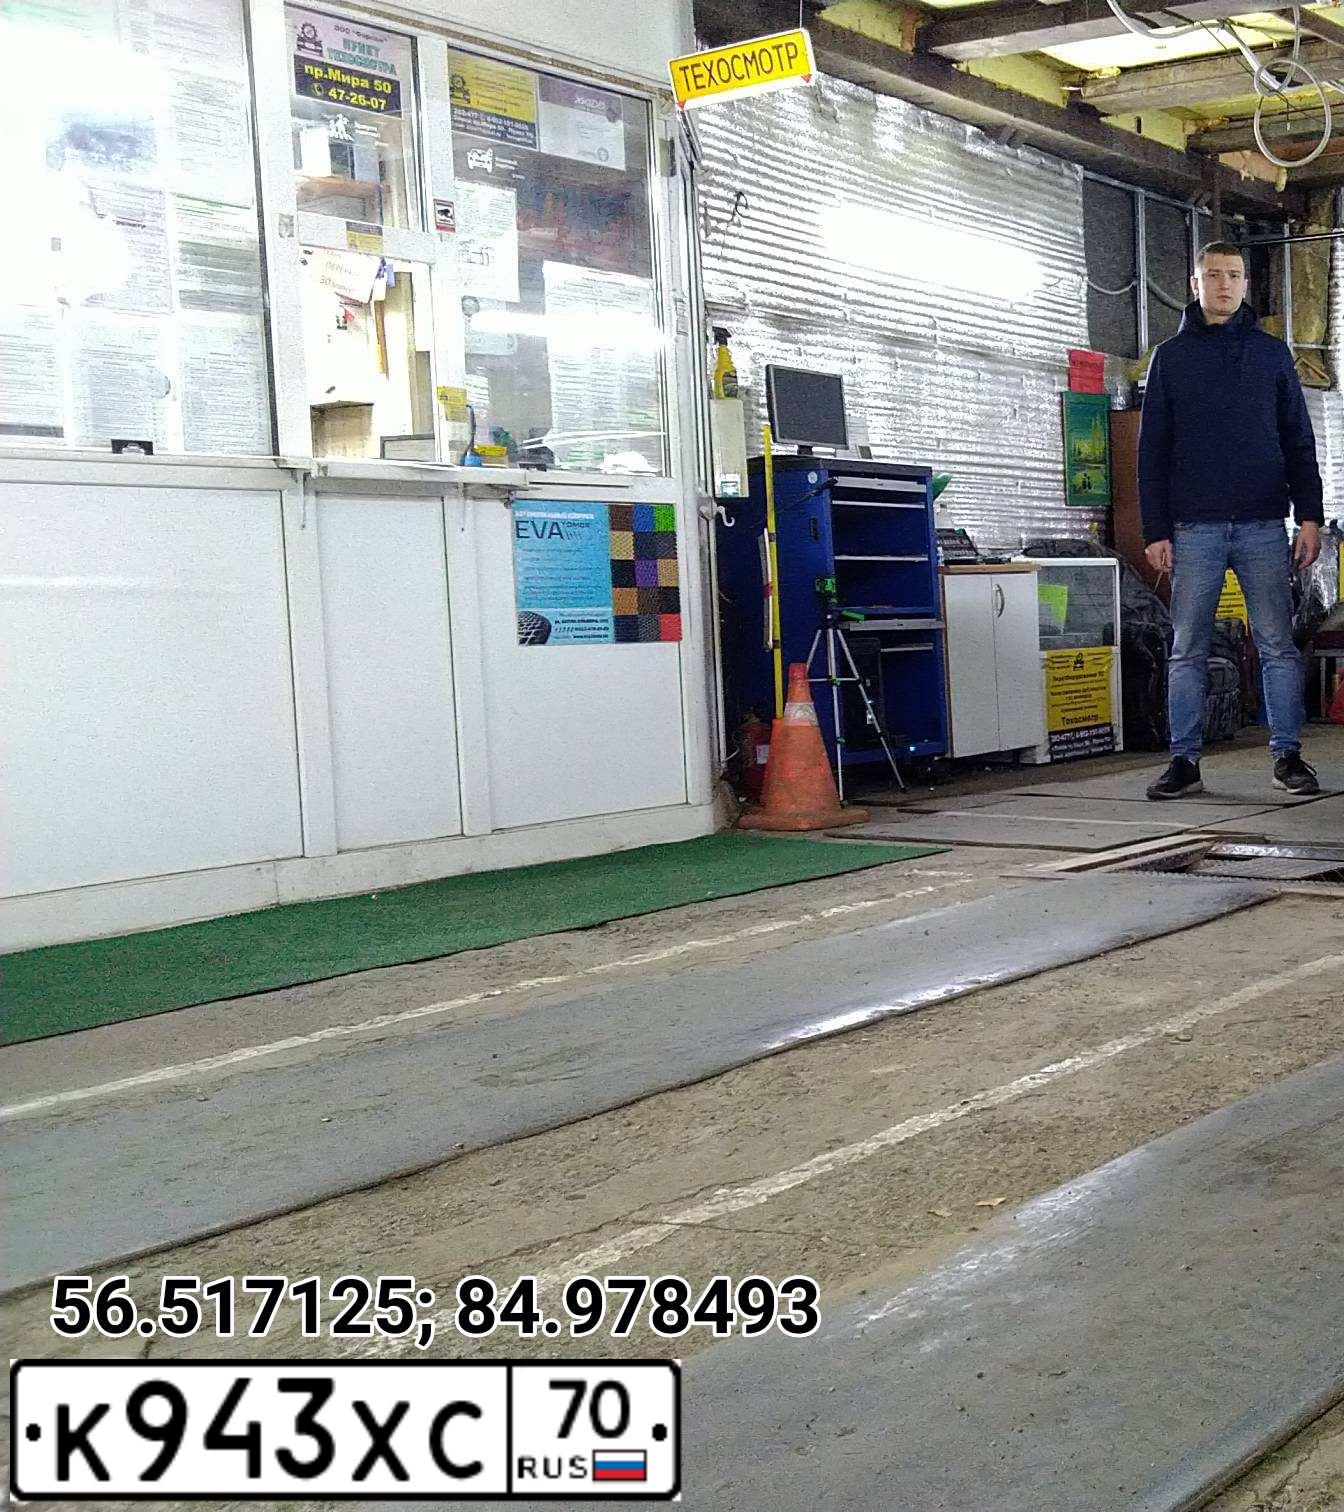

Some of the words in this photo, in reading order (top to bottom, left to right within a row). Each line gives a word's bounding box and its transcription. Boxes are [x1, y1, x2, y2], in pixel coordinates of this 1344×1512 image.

[304, 64, 369, 89] пр.Мира
[374, 80, 392, 94] 50
[679, 42, 798, 92] ТЕХОСМОТР
[328, 87, 387, 110] 47-26-07
[515, 520, 564, 540] EVA
